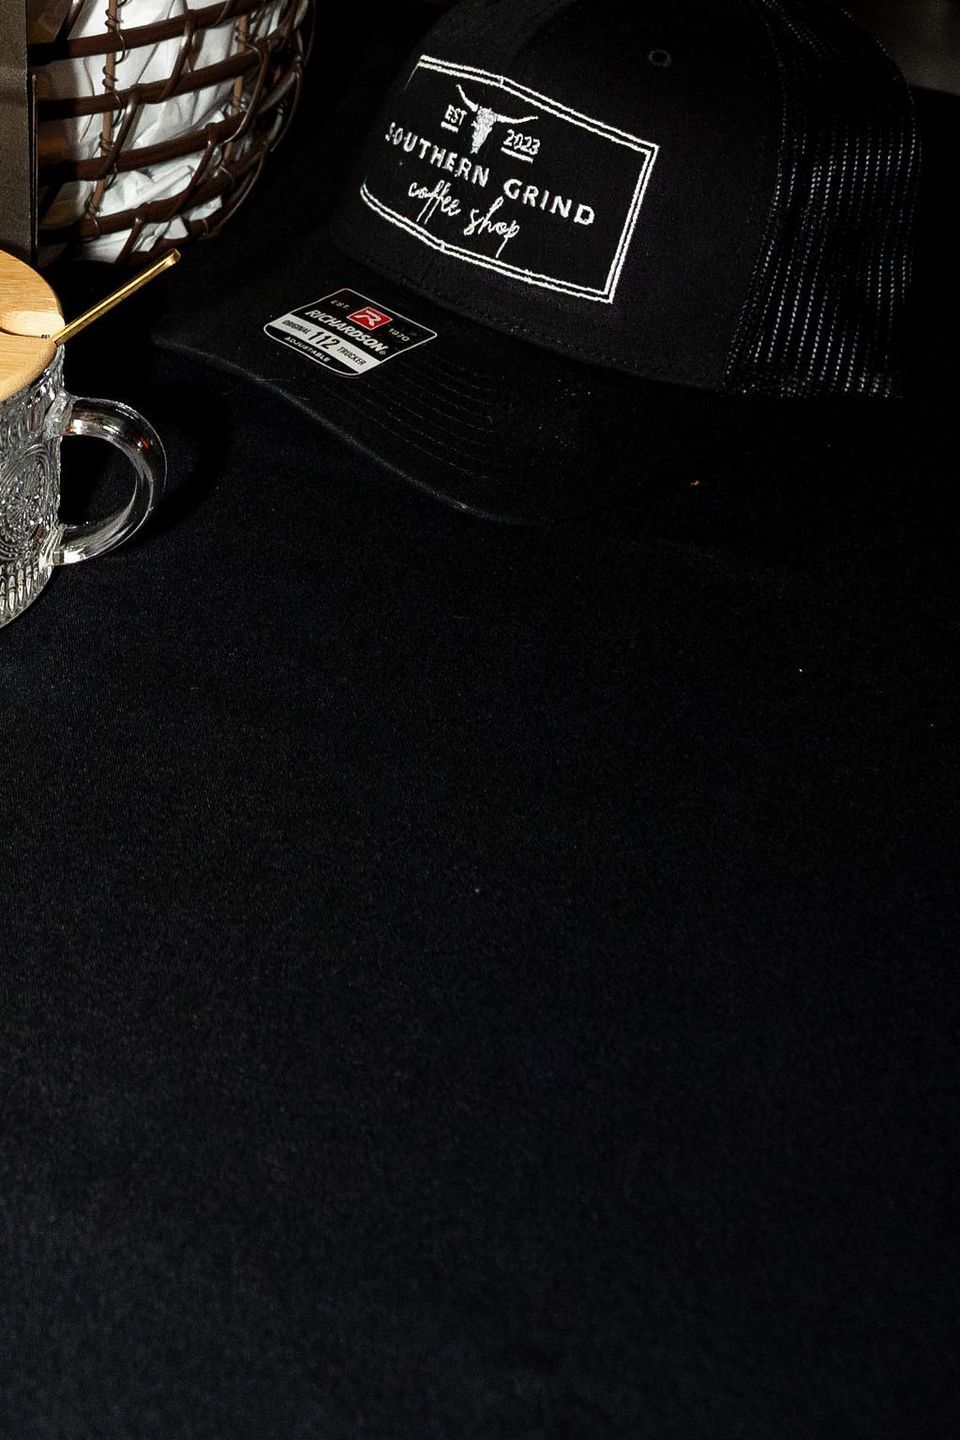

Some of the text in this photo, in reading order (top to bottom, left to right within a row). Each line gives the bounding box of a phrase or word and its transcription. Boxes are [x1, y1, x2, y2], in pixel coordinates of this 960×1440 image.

[443, 104, 466, 126] EST
[384, 121, 595, 226] SOUTHERN GRIND
[408, 179, 521, 259] coffee shop
[284, 336, 331, 362] ADJUSTABLE
[308, 331, 340, 350] 112
[338, 346, 367, 366] TRUCKER
